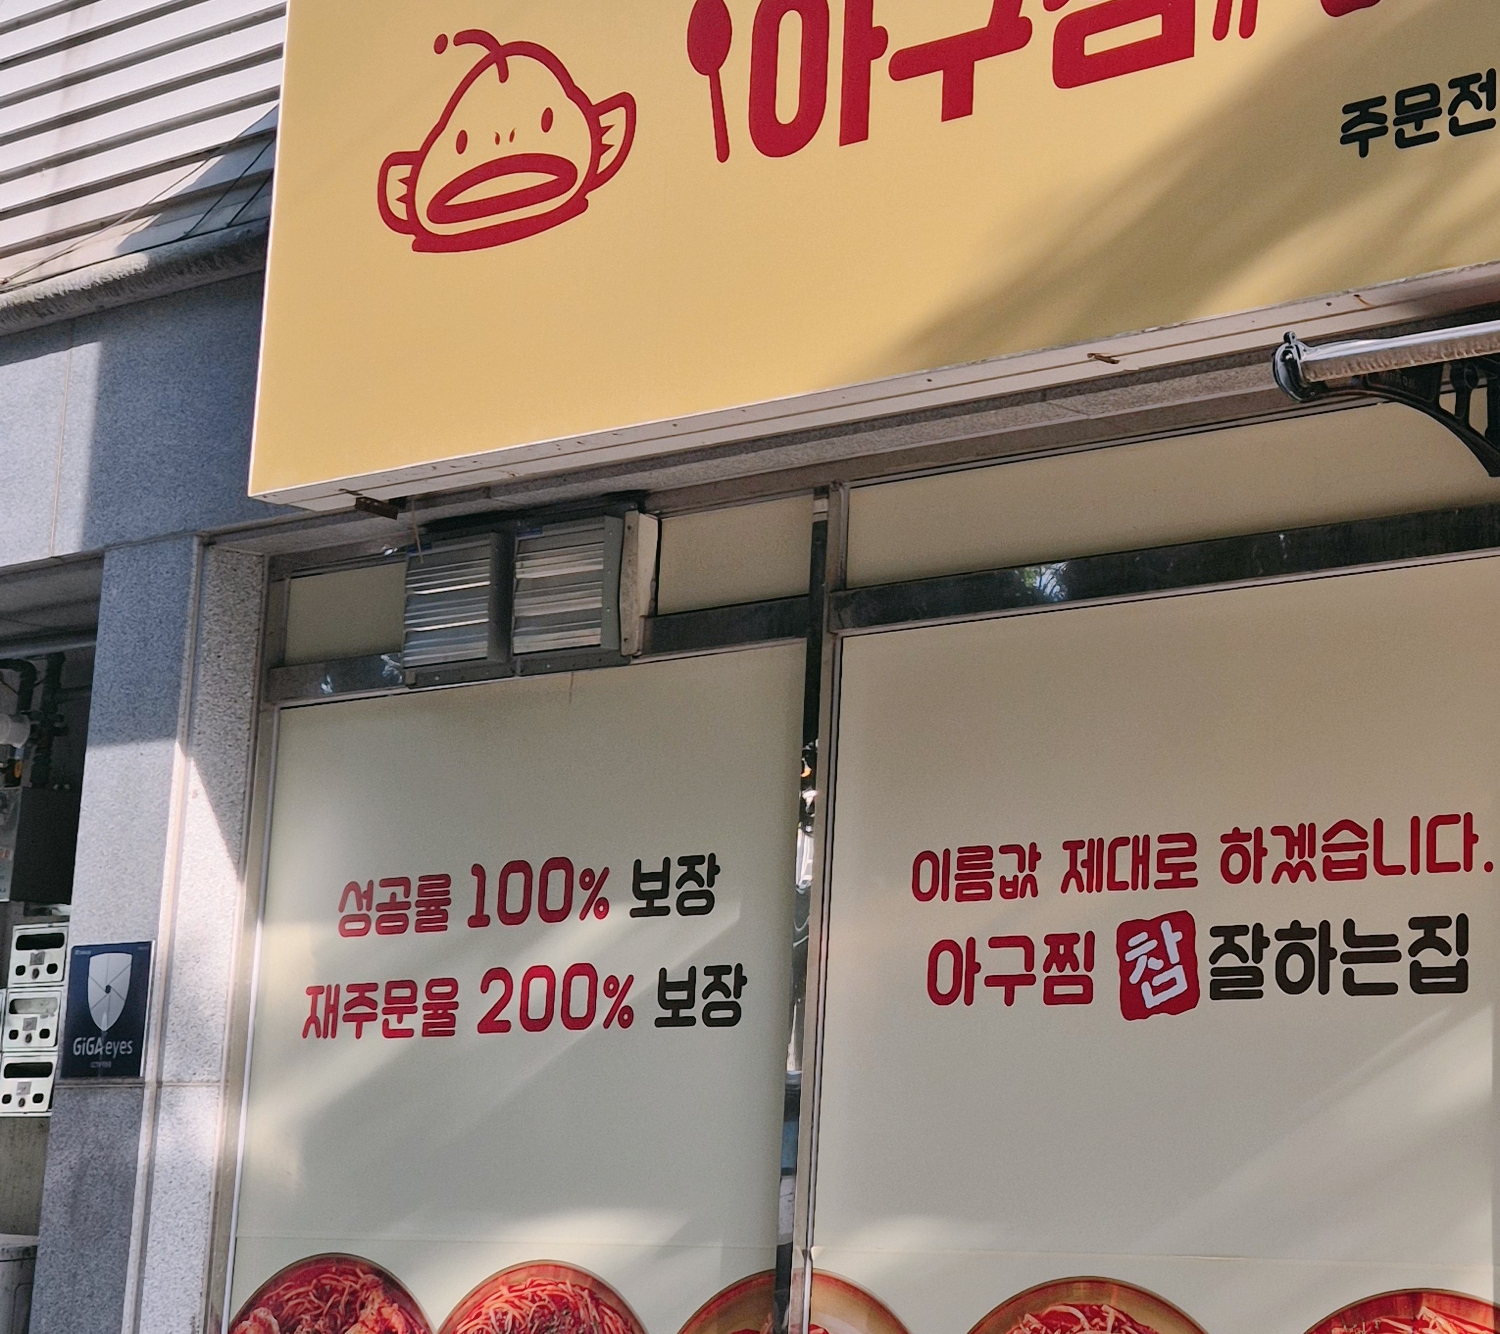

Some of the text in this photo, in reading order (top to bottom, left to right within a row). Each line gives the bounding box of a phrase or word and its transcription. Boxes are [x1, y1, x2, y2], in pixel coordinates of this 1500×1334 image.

[337, 852, 721, 938] 성공률 100% 보장
[911, 811, 1494, 903] 이름값 제대로 하겠습니다.
[301, 962, 748, 1040] 재주문율 200% 보장
[926, 930, 1096, 1007] 아구찜
[1208, 912, 1470, 1001] 잘하는집
